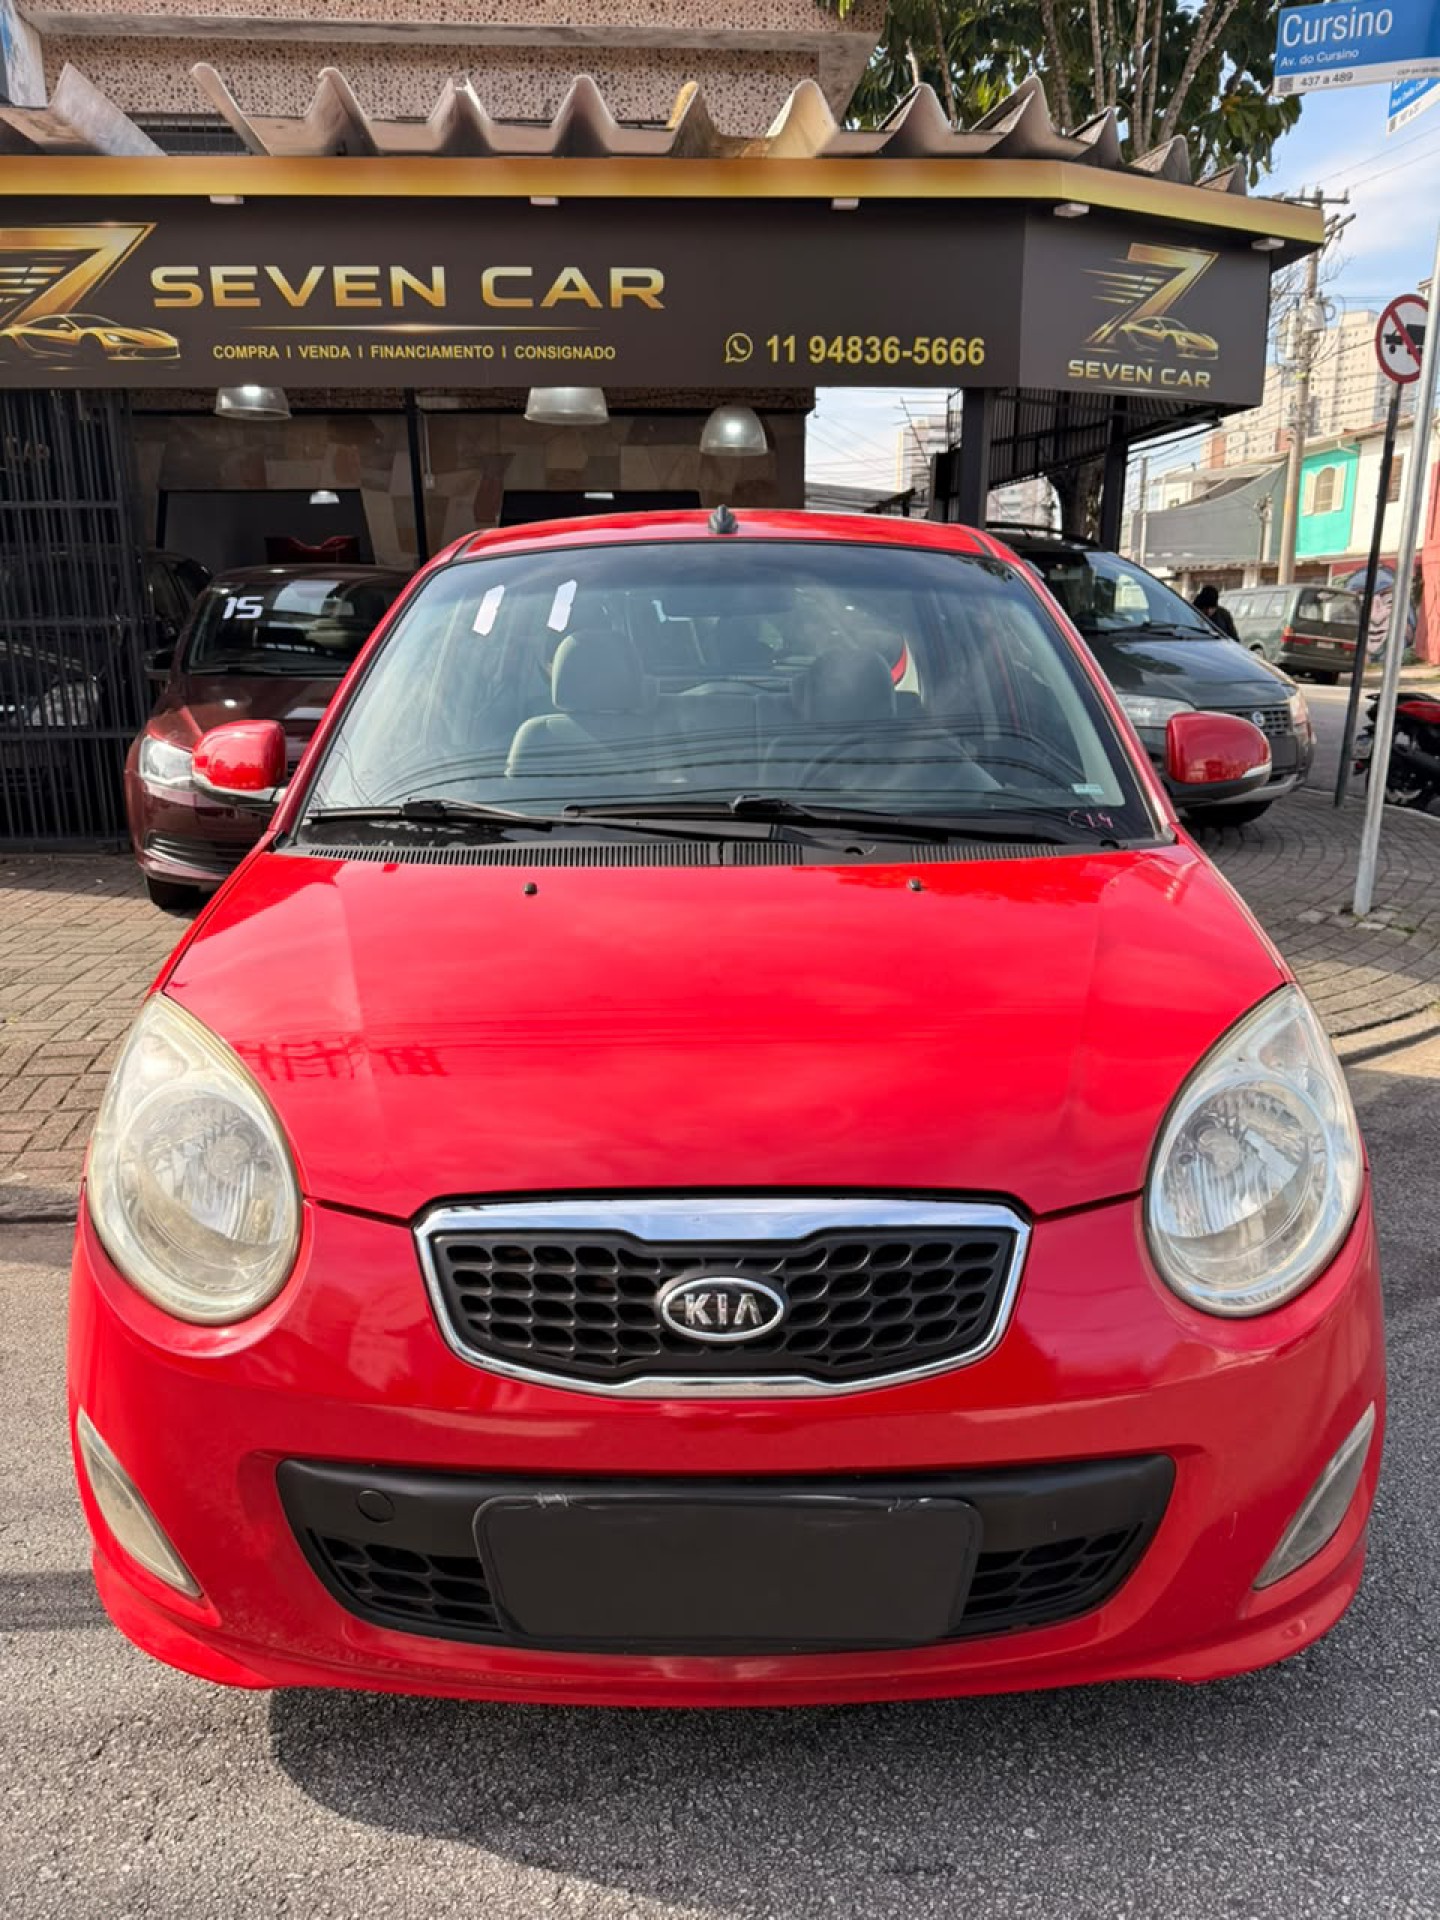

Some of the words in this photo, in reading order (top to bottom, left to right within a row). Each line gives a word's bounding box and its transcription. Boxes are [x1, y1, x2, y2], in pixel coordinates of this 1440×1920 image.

[1283, 6, 1393, 47] Cursino
[1300, 53, 1315, 65] do
[1316, 49, 1360, 63] Cursino
[150, 266, 447, 308] SEVEN
[481, 266, 666, 309] CAR
[213, 345, 280, 359] COMPRA
[298, 345, 352, 359] VENDA
[371, 345, 495, 359] FINANCIAMENTO
[514, 345, 616, 360] CONSIGNADO
[766, 336, 796, 363] 11
[809, 336, 986, 365] 94836-5666
[1067, 359, 1153, 384] SEVEN
[1160, 368, 1212, 388] CAR
[222, 596, 265, 619] 15
[684, 1292, 763, 1325] KIA
